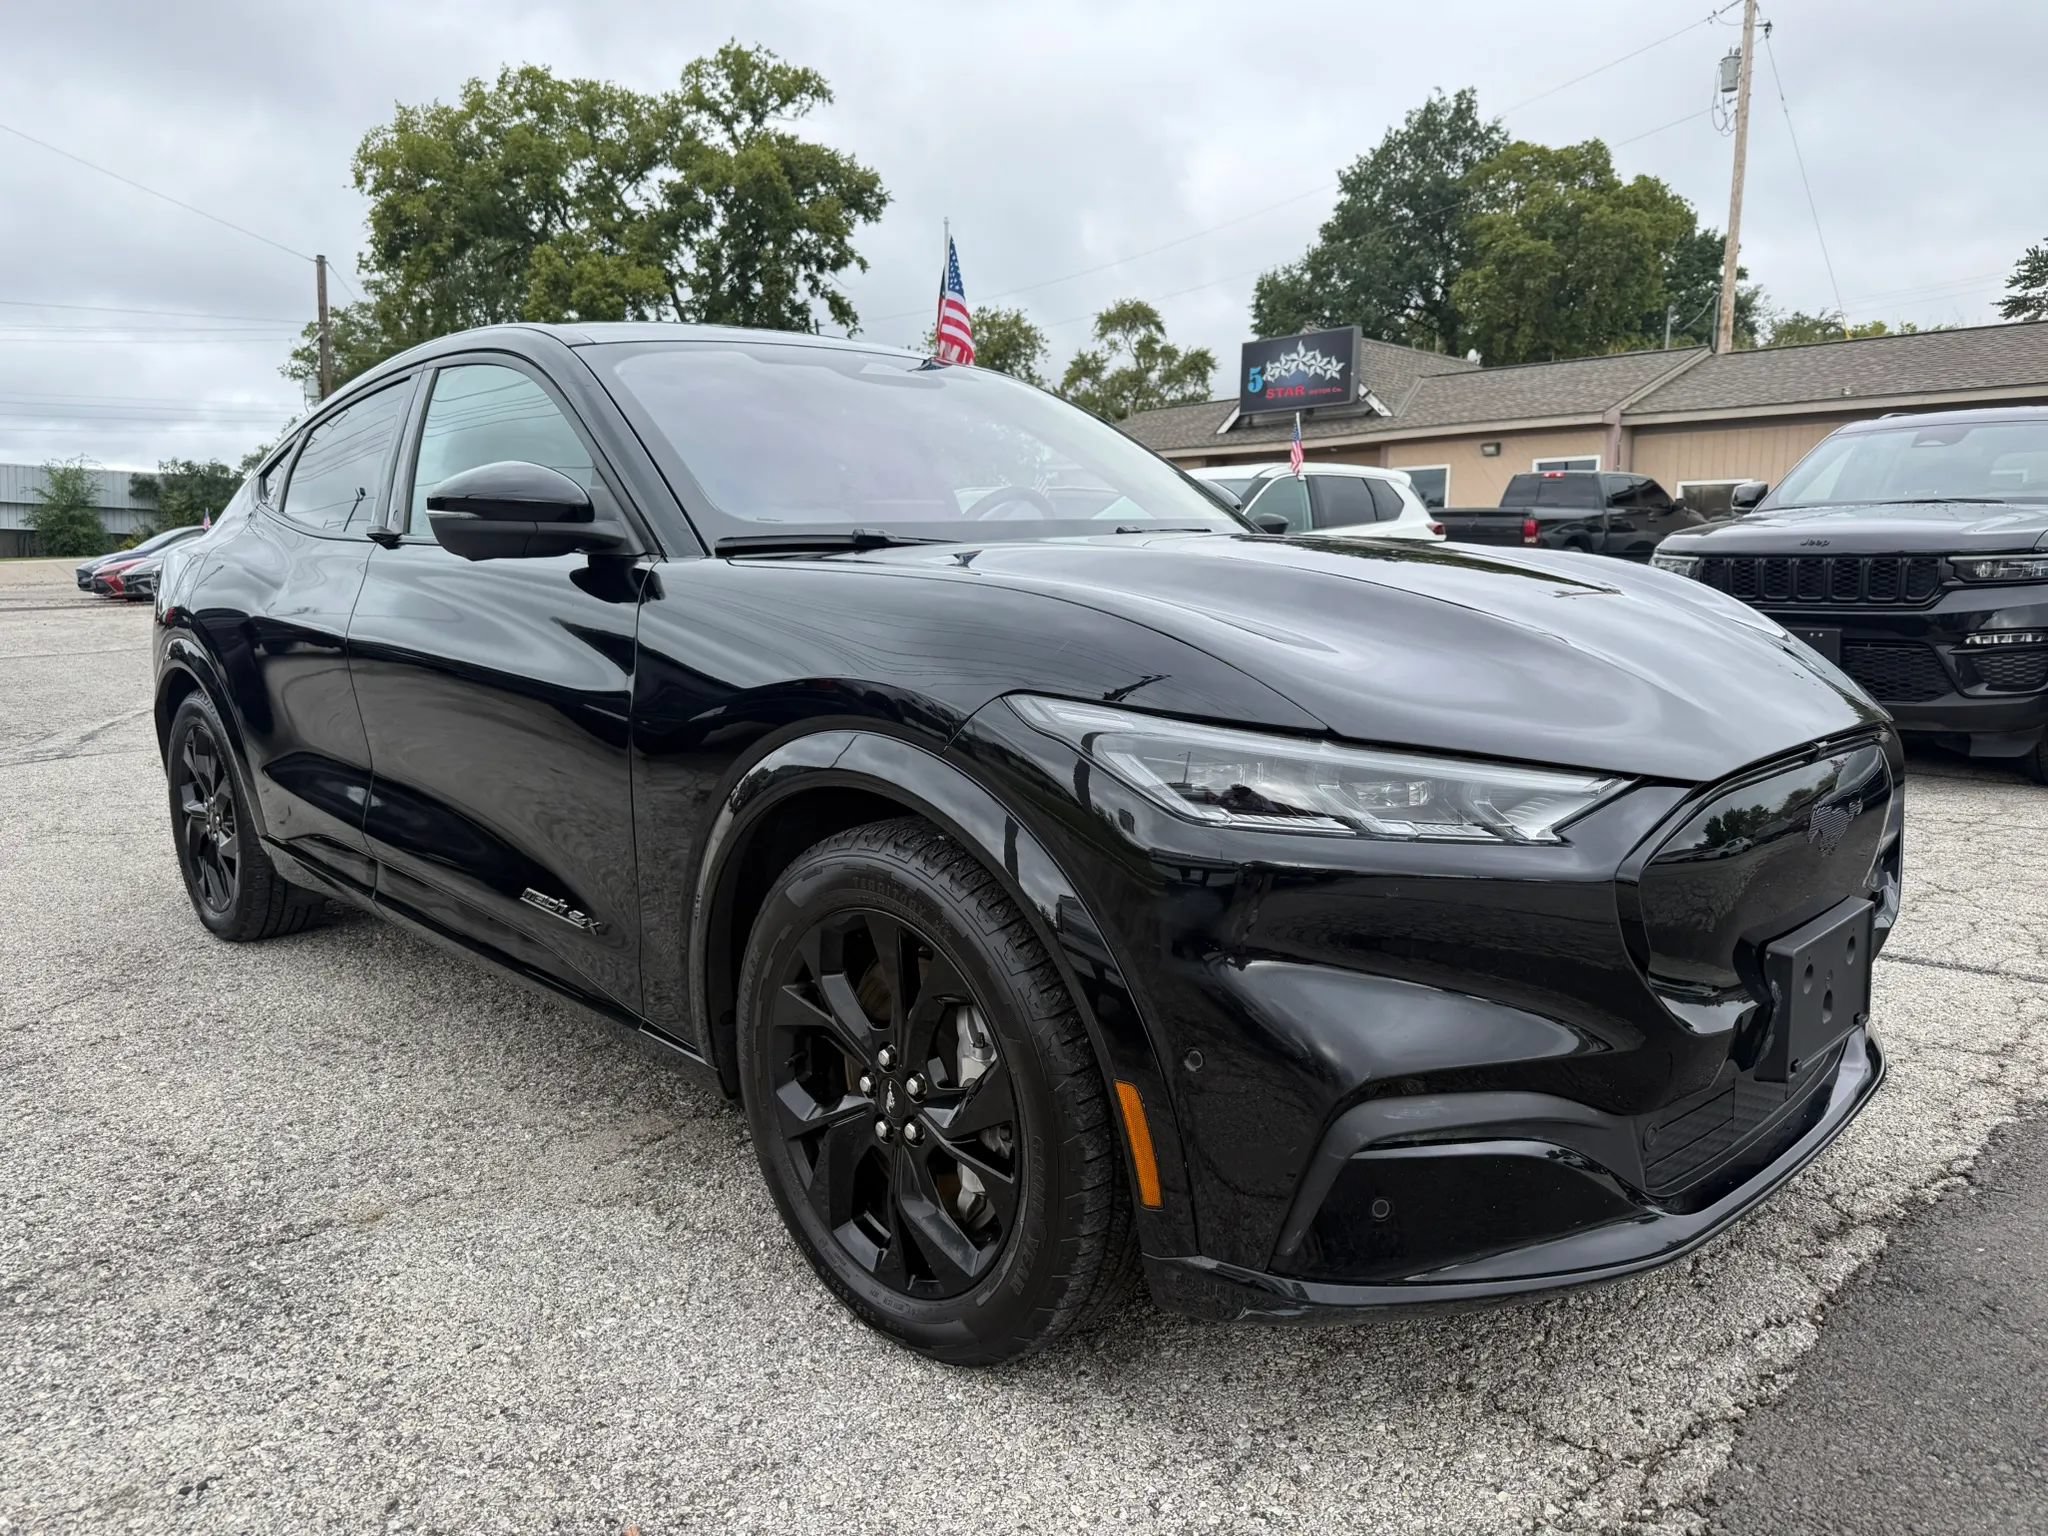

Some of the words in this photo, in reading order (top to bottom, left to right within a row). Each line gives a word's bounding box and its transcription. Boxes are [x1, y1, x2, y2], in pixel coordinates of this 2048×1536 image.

[1248, 367, 1265, 393] 5
[1266, 385, 1306, 399] STAR
[1800, 539, 1831, 547] Jeep
